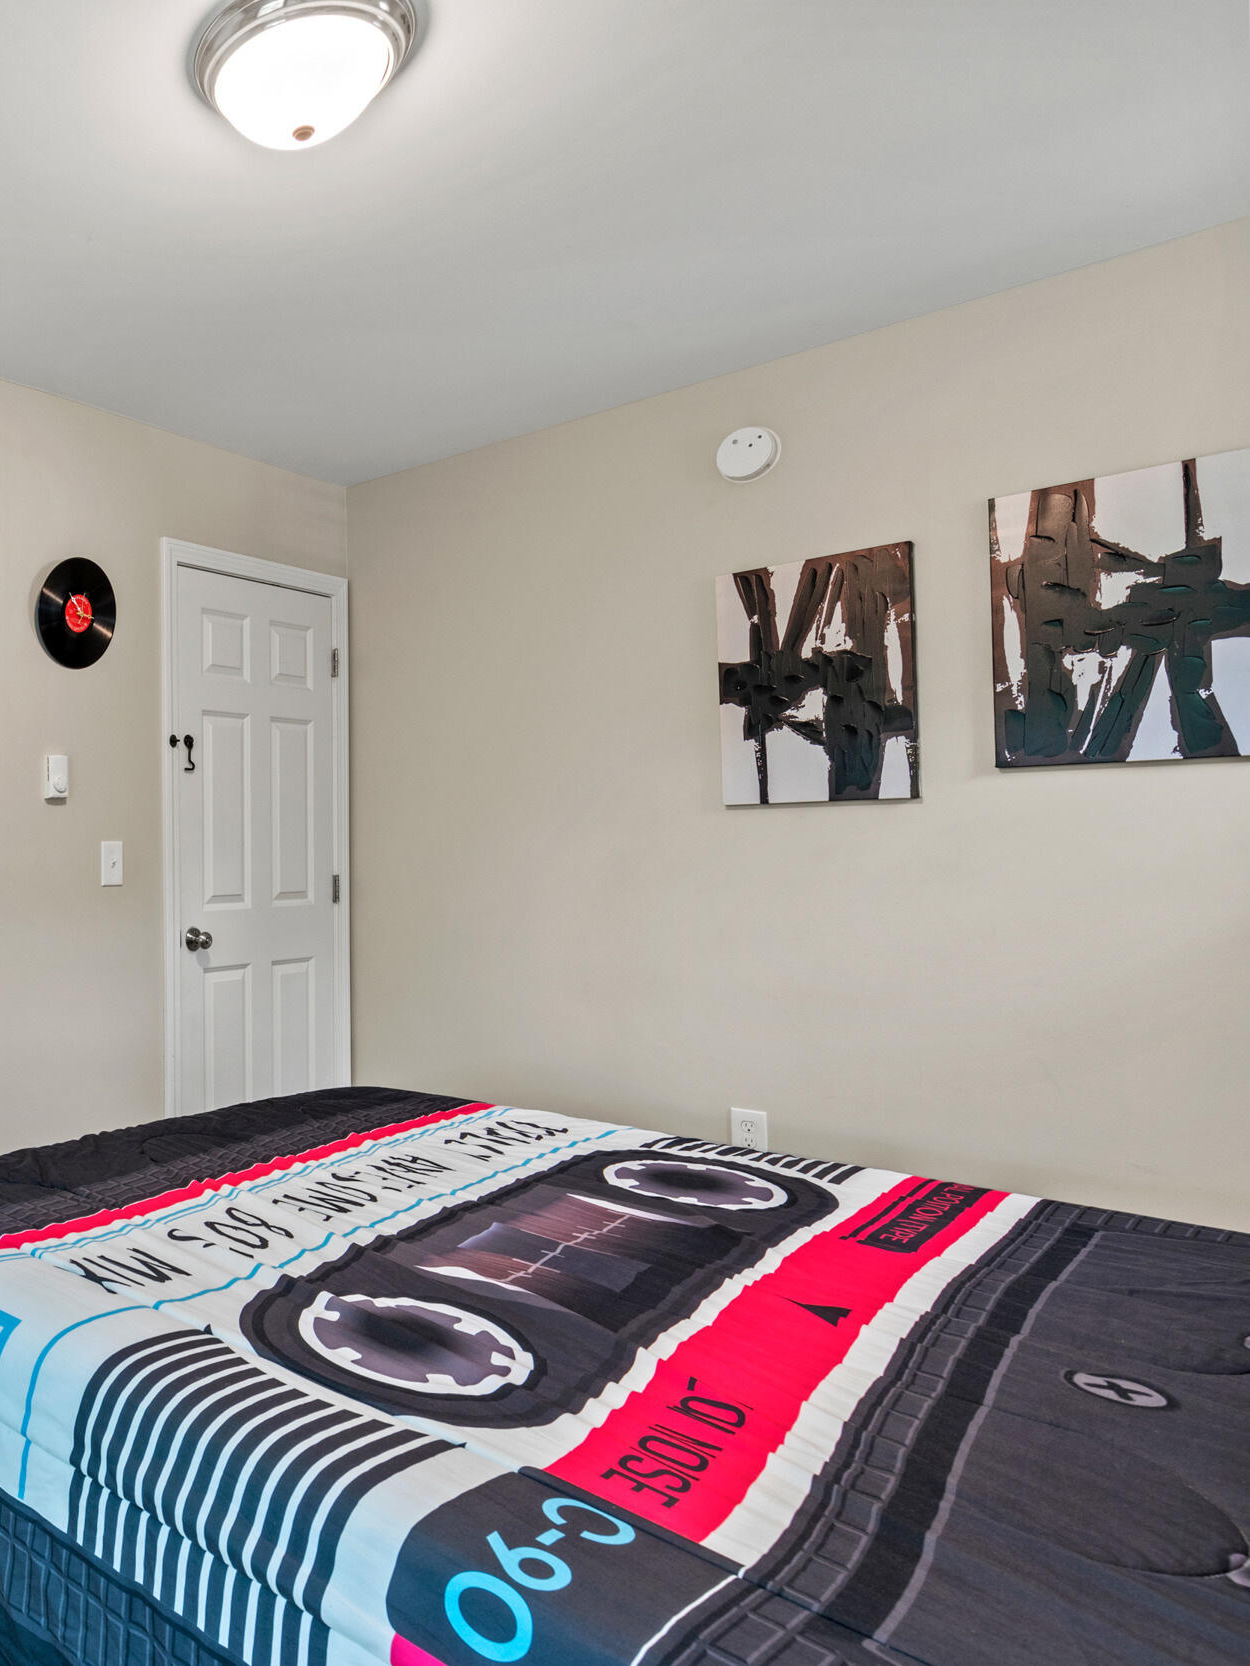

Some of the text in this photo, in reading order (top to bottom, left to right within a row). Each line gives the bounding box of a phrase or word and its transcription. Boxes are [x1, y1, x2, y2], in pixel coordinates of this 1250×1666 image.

[53, 1247, 193, 1295] MIX
[599, 1423, 723, 1509] NOISE
[443, 1497, 637, 1663] C-90
